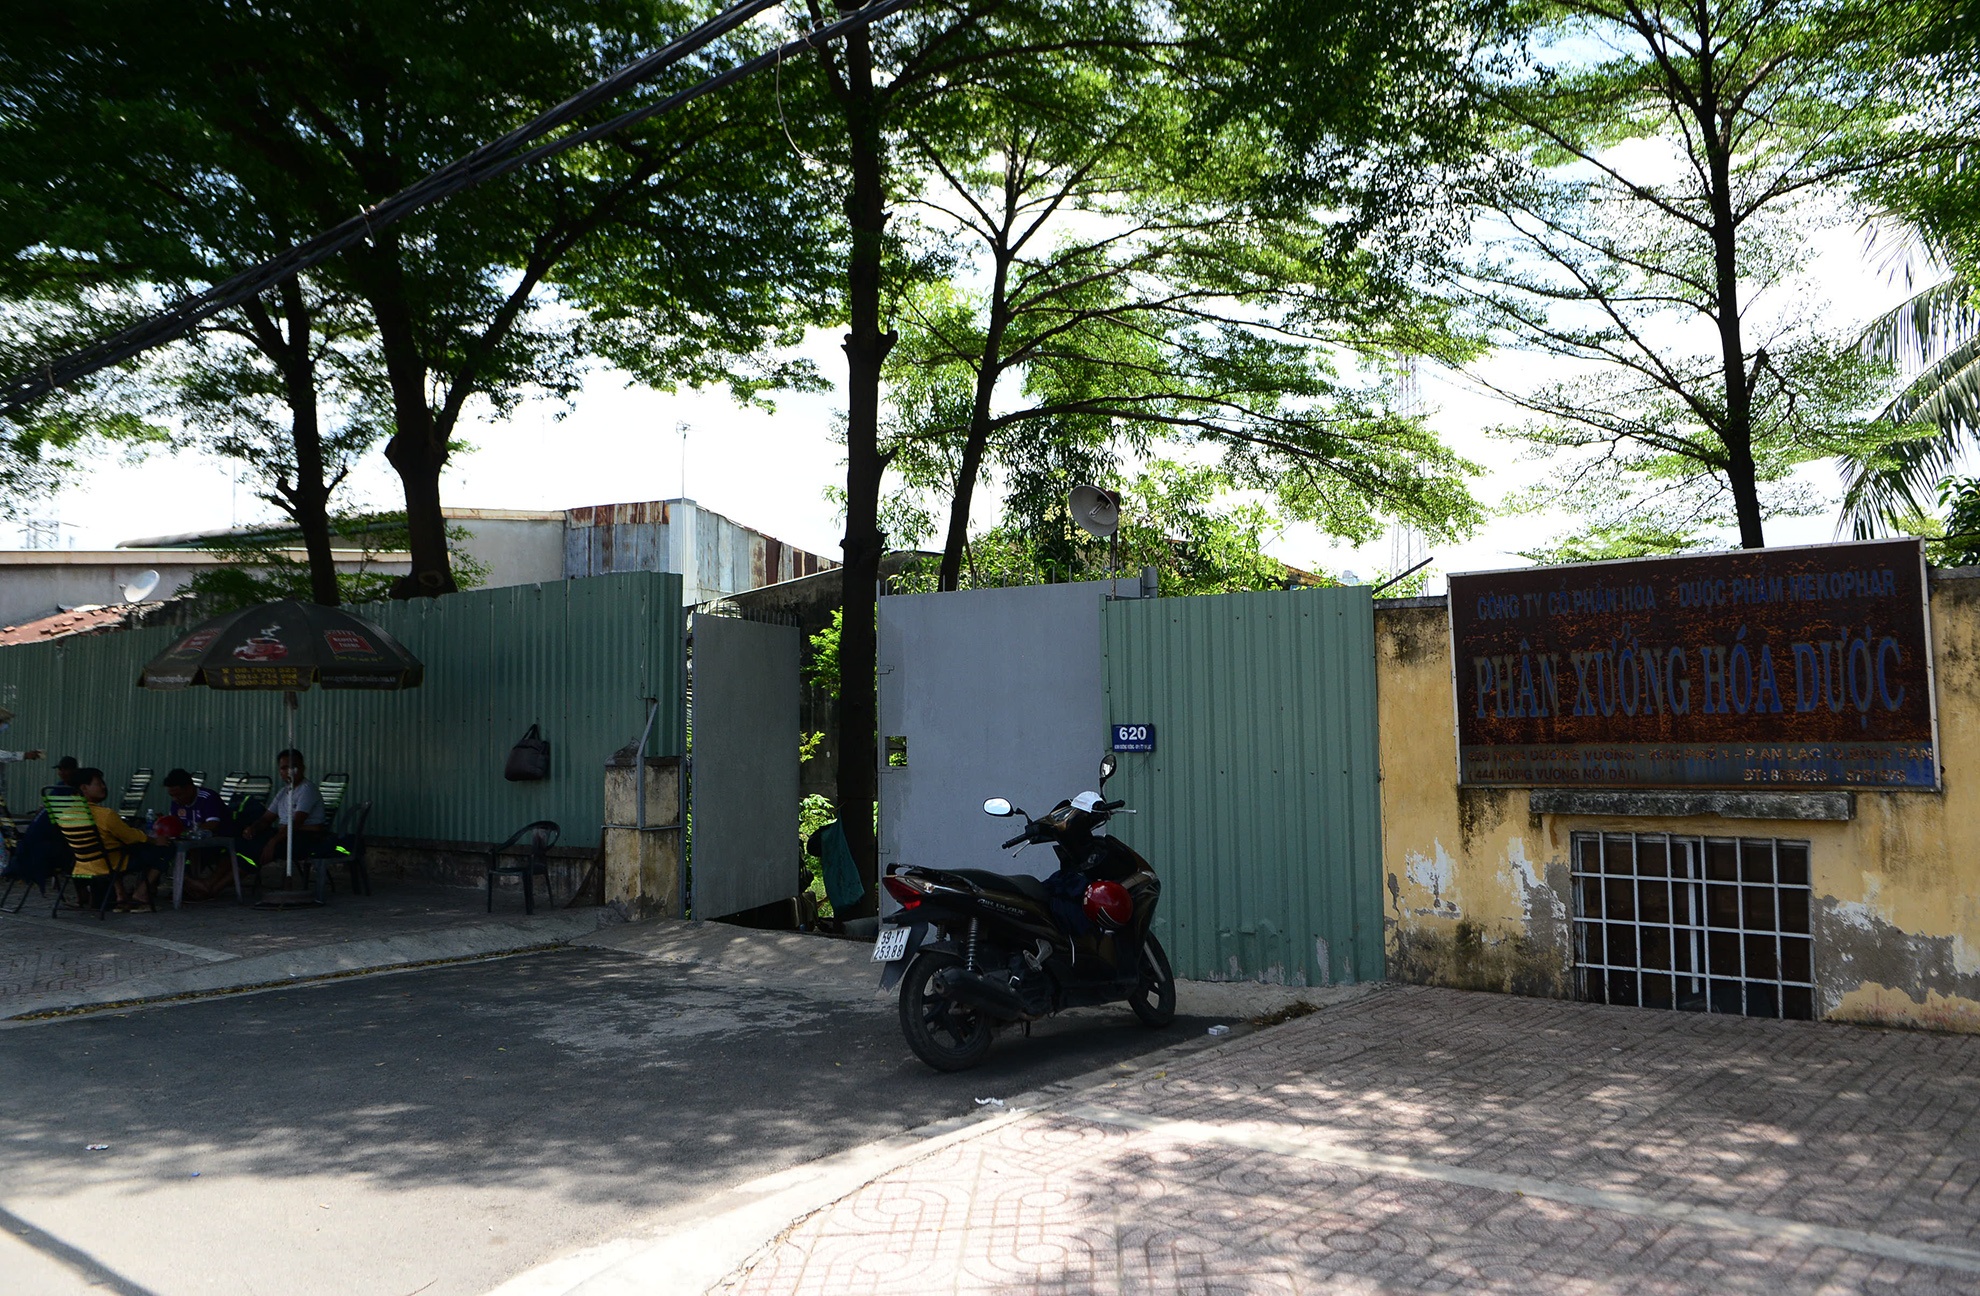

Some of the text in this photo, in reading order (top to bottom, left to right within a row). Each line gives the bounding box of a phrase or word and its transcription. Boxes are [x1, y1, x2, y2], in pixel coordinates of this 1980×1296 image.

[1477, 590, 1520, 620] CÔNG
[1523, 592, 1543, 618] TY
[1547, 578, 1570, 615] CỔ
[1573, 578, 1617, 615] PHẦN
[1789, 569, 1896, 601] MEKOPHAR
[1473, 622, 1906, 731] PHÂN XƯỞNG HÓA DƯỢC
[1118, 726, 1147, 741] 620
[881, 929, 904, 945] 59-Y1
[874, 944, 904, 960] 253.88
